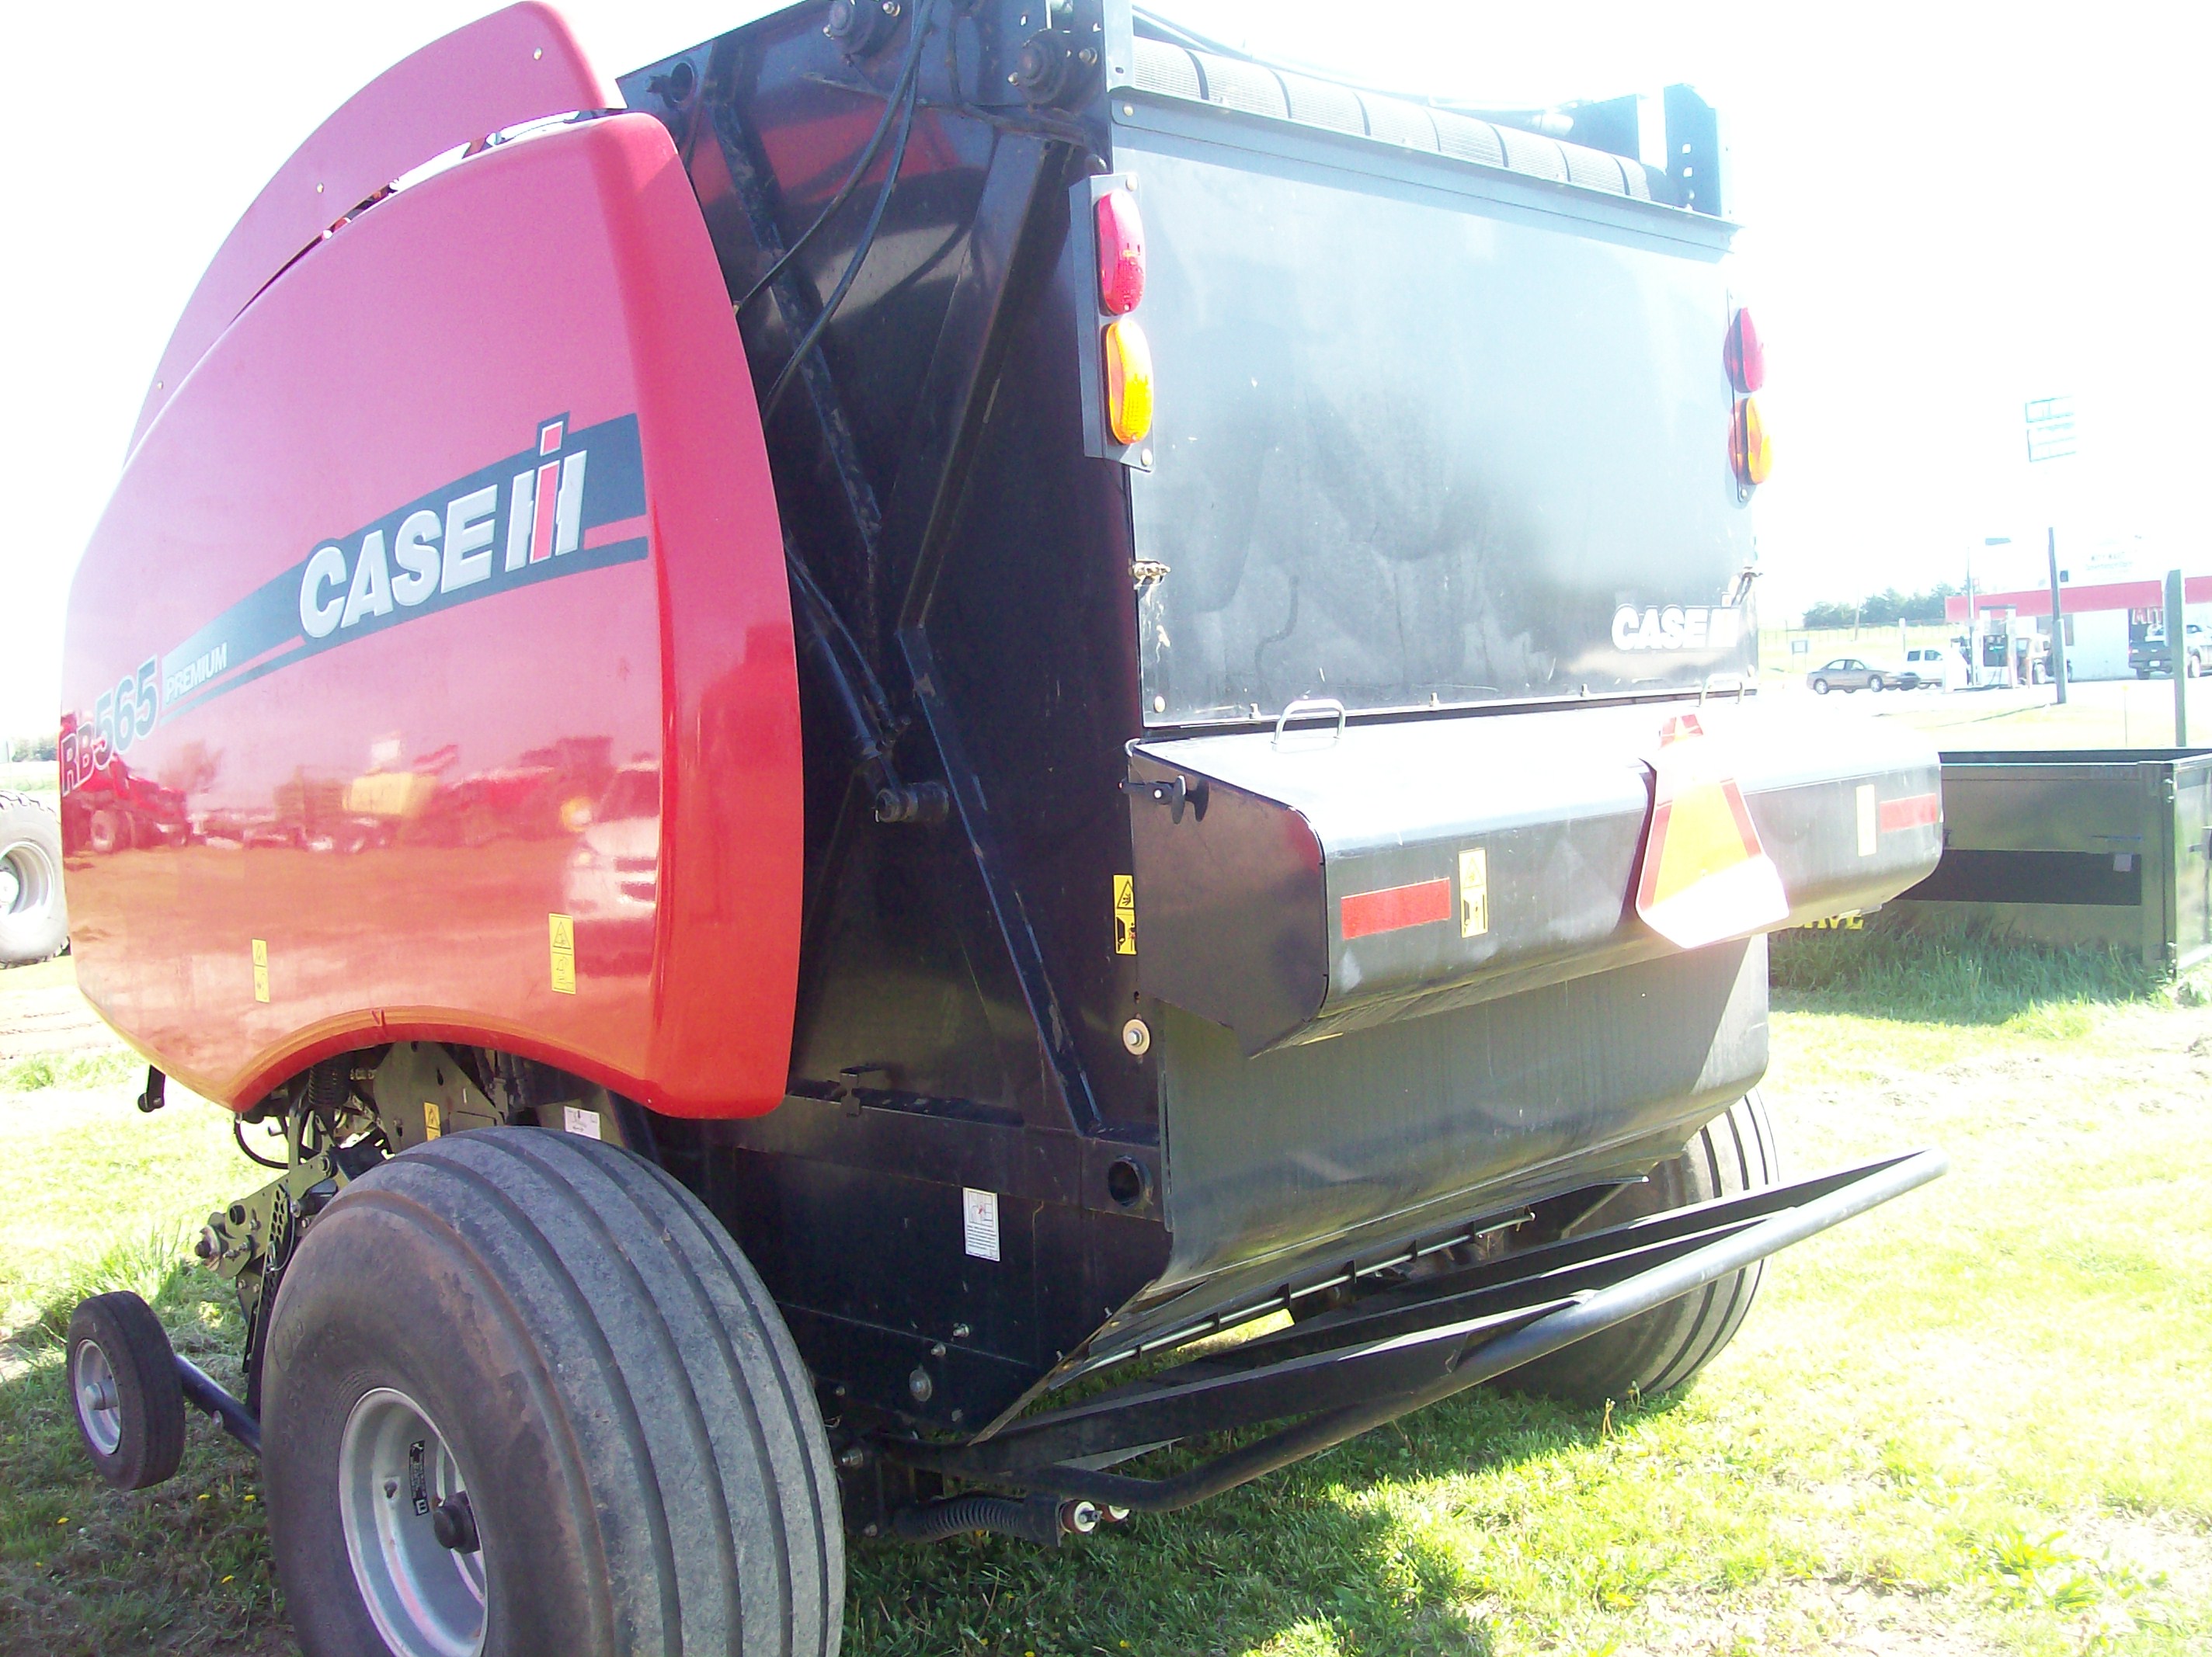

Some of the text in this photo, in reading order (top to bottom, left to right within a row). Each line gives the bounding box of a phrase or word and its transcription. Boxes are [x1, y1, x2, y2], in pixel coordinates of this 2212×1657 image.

[300, 485, 498, 638] CASE
[1611, 606, 1708, 651] CASE
[61, 642, 228, 797] RB565 PREMIUM
